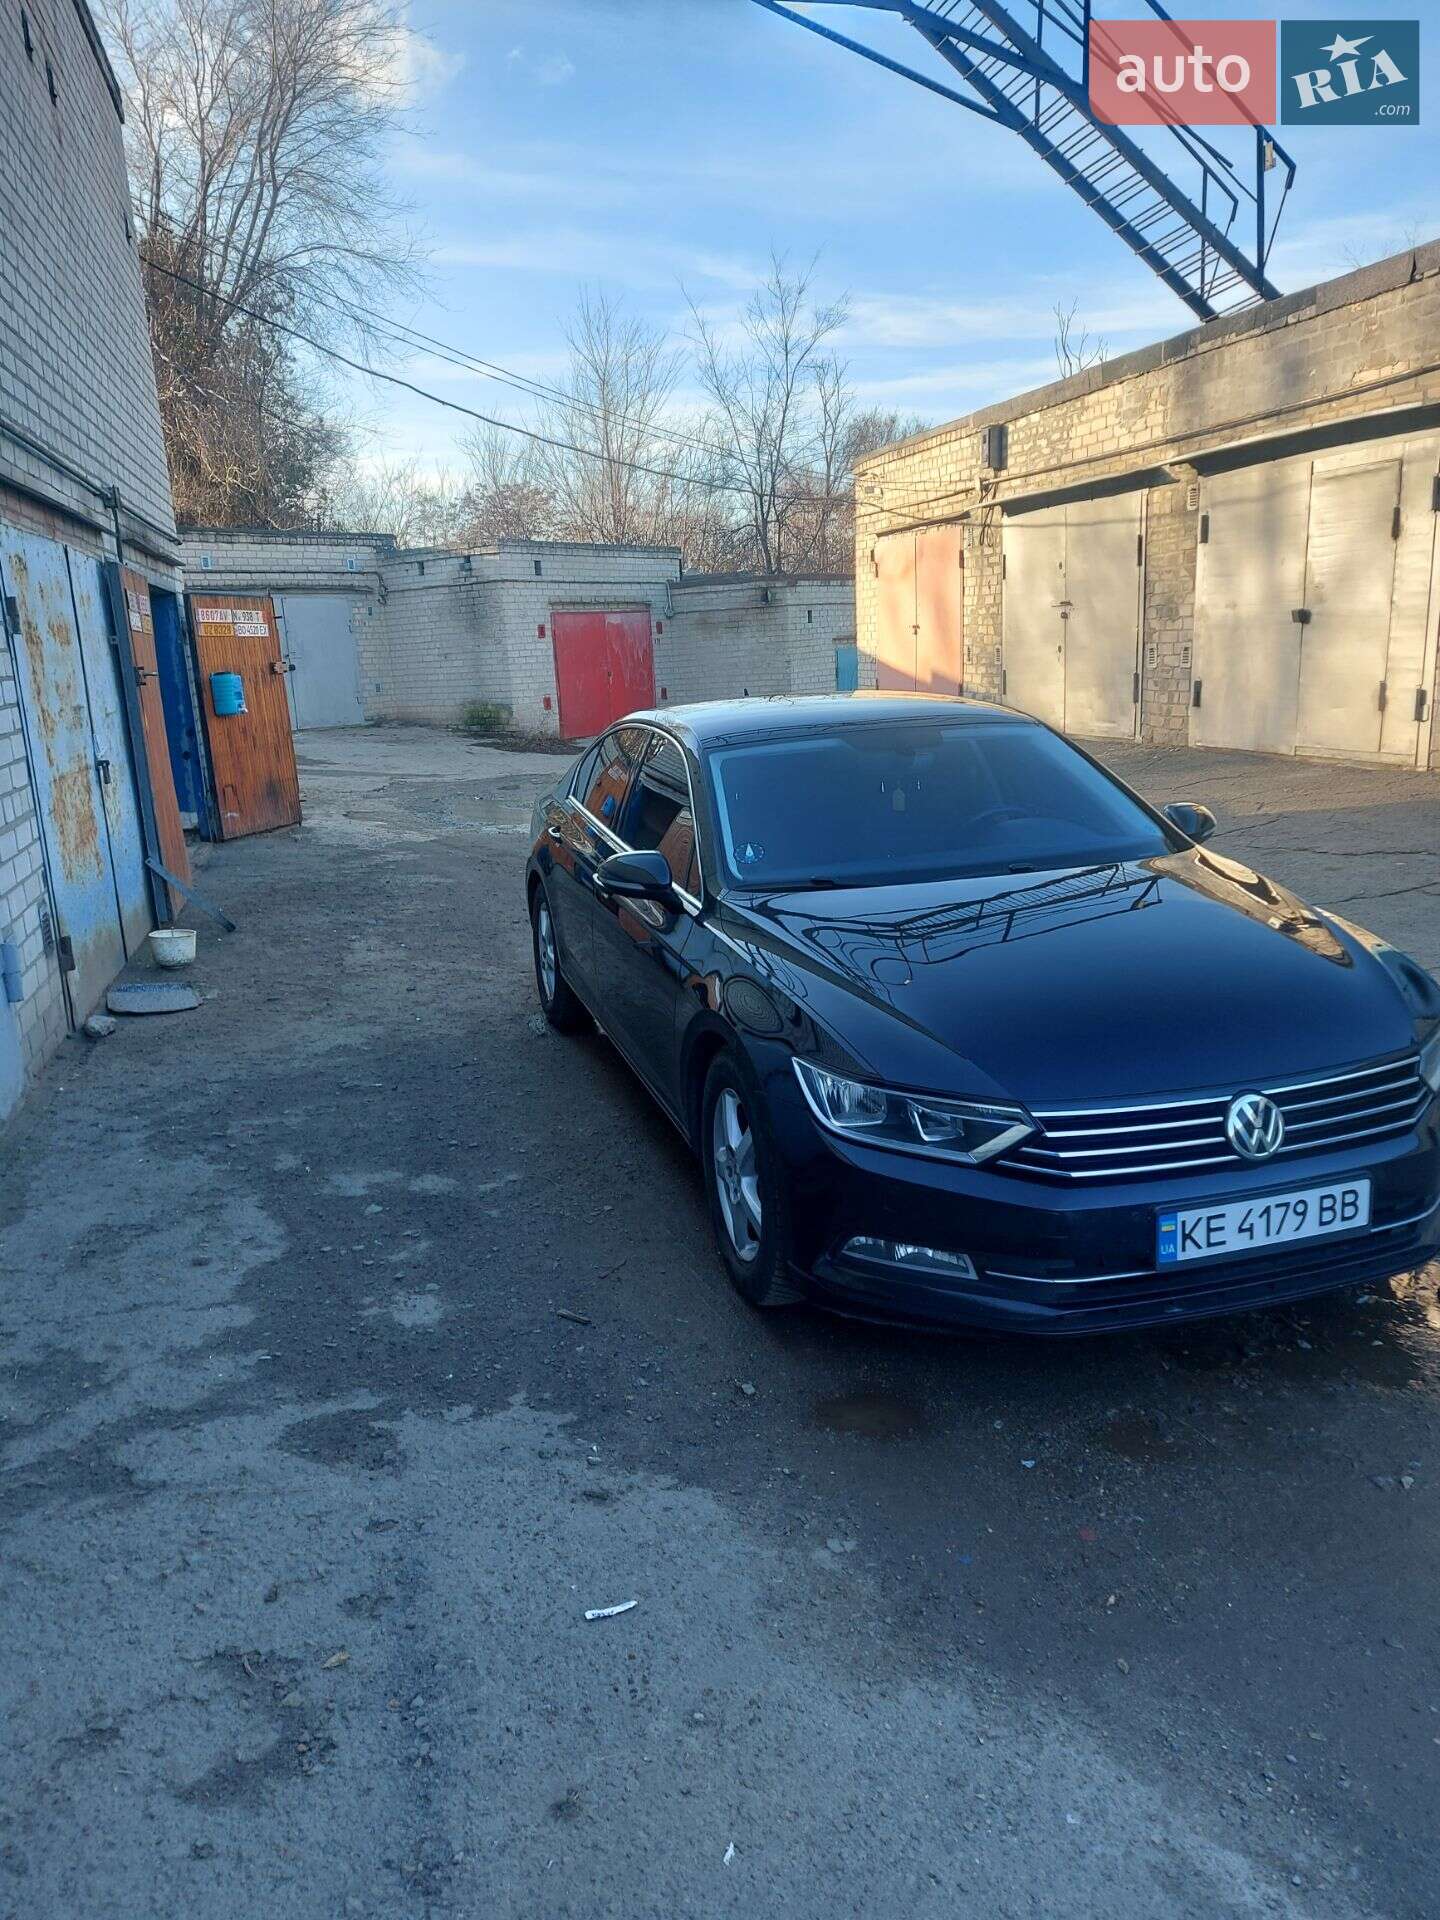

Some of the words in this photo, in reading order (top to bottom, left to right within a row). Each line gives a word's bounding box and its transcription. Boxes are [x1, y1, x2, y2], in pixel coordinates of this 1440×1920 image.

[1181, 1213, 1227, 1253] KE
[1237, 1199, 1309, 1240] 4179
[1318, 1188, 1360, 1227] BB
[1160, 1244, 1176, 1255] UA
